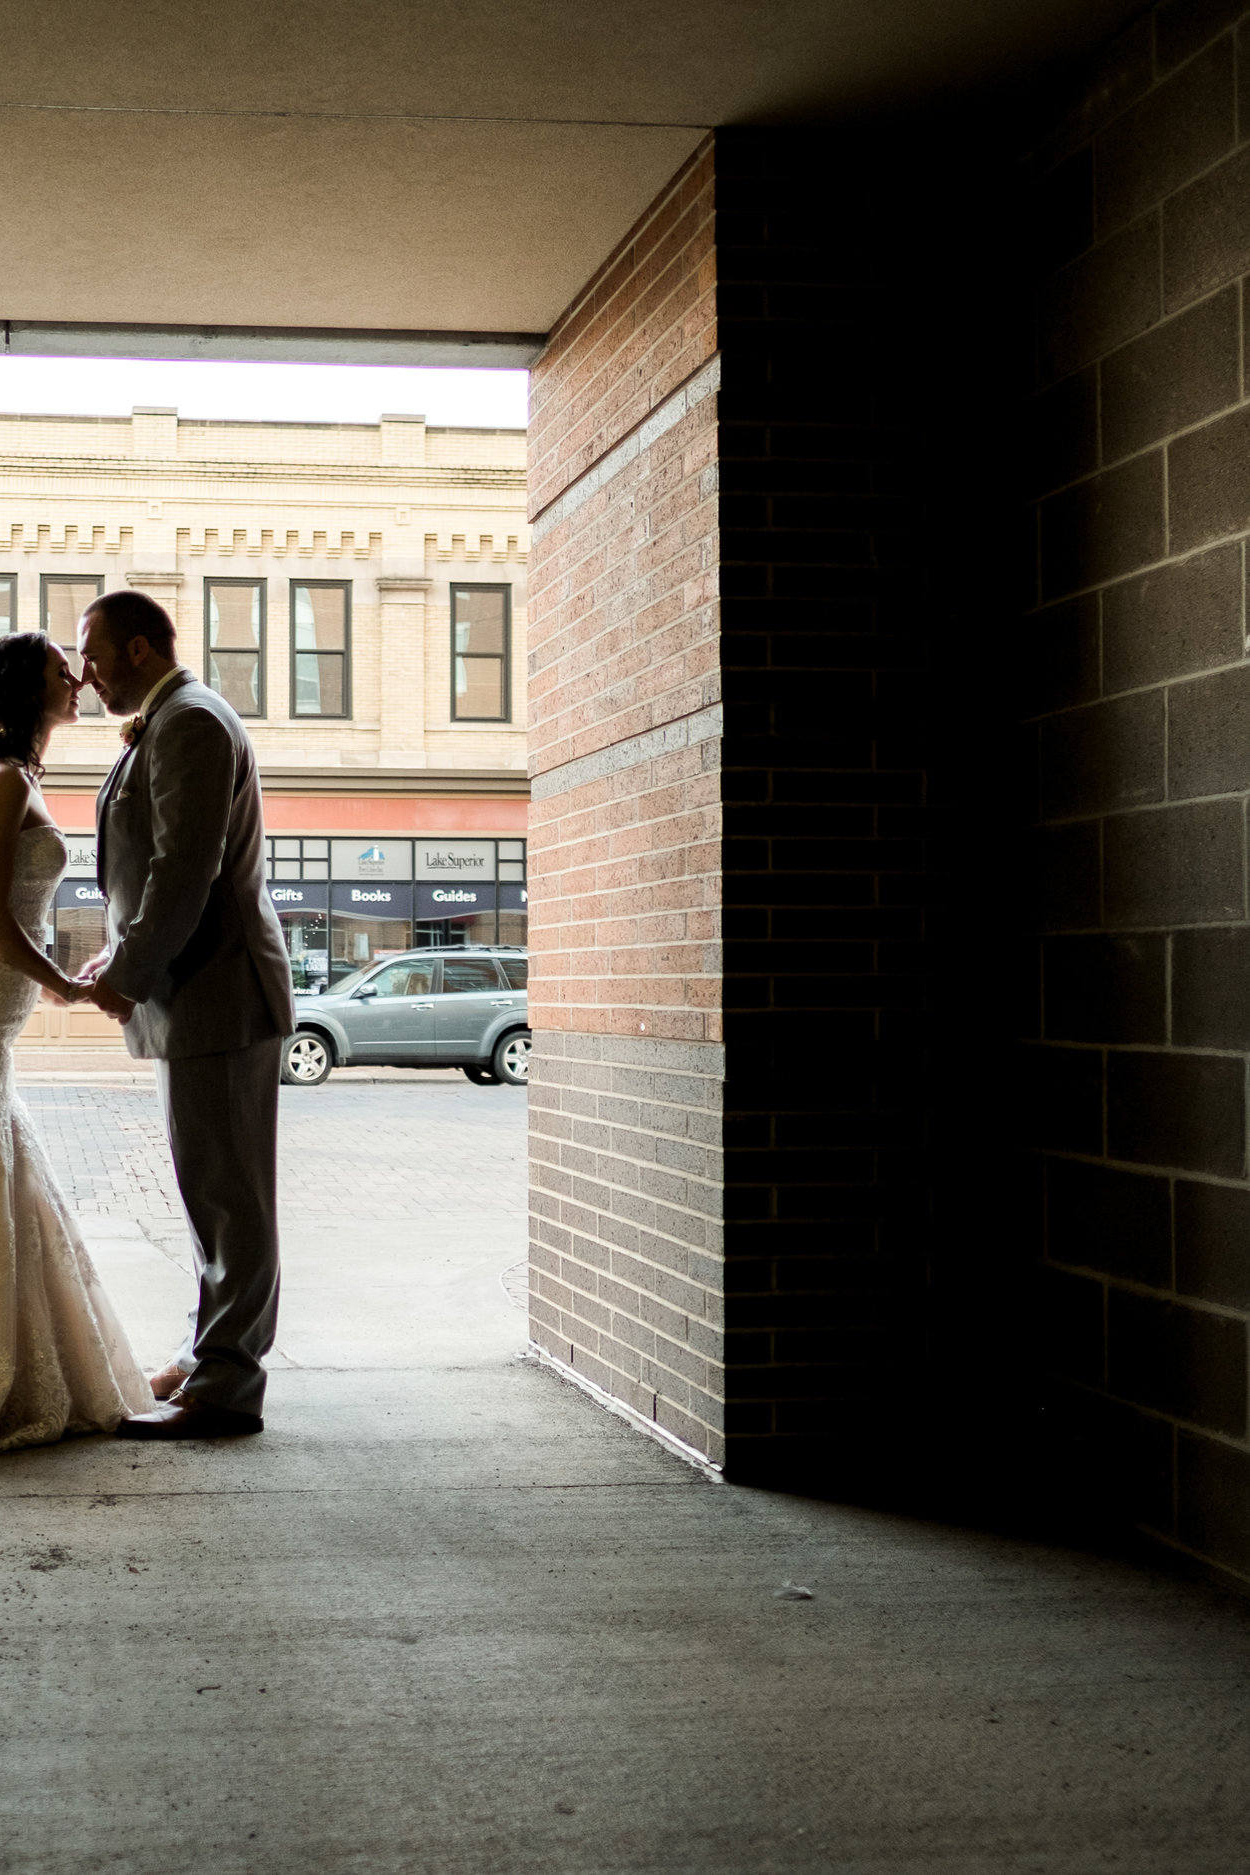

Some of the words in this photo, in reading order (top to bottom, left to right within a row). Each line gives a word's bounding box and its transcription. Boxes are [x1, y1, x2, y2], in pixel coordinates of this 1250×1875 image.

[68, 849, 90, 864] Lake
[425, 852, 448, 867] Lake
[447, 852, 485, 870] Superior
[270, 888, 304, 902] Gifts
[351, 889, 392, 902] Books
[432, 889, 477, 903] Guides
